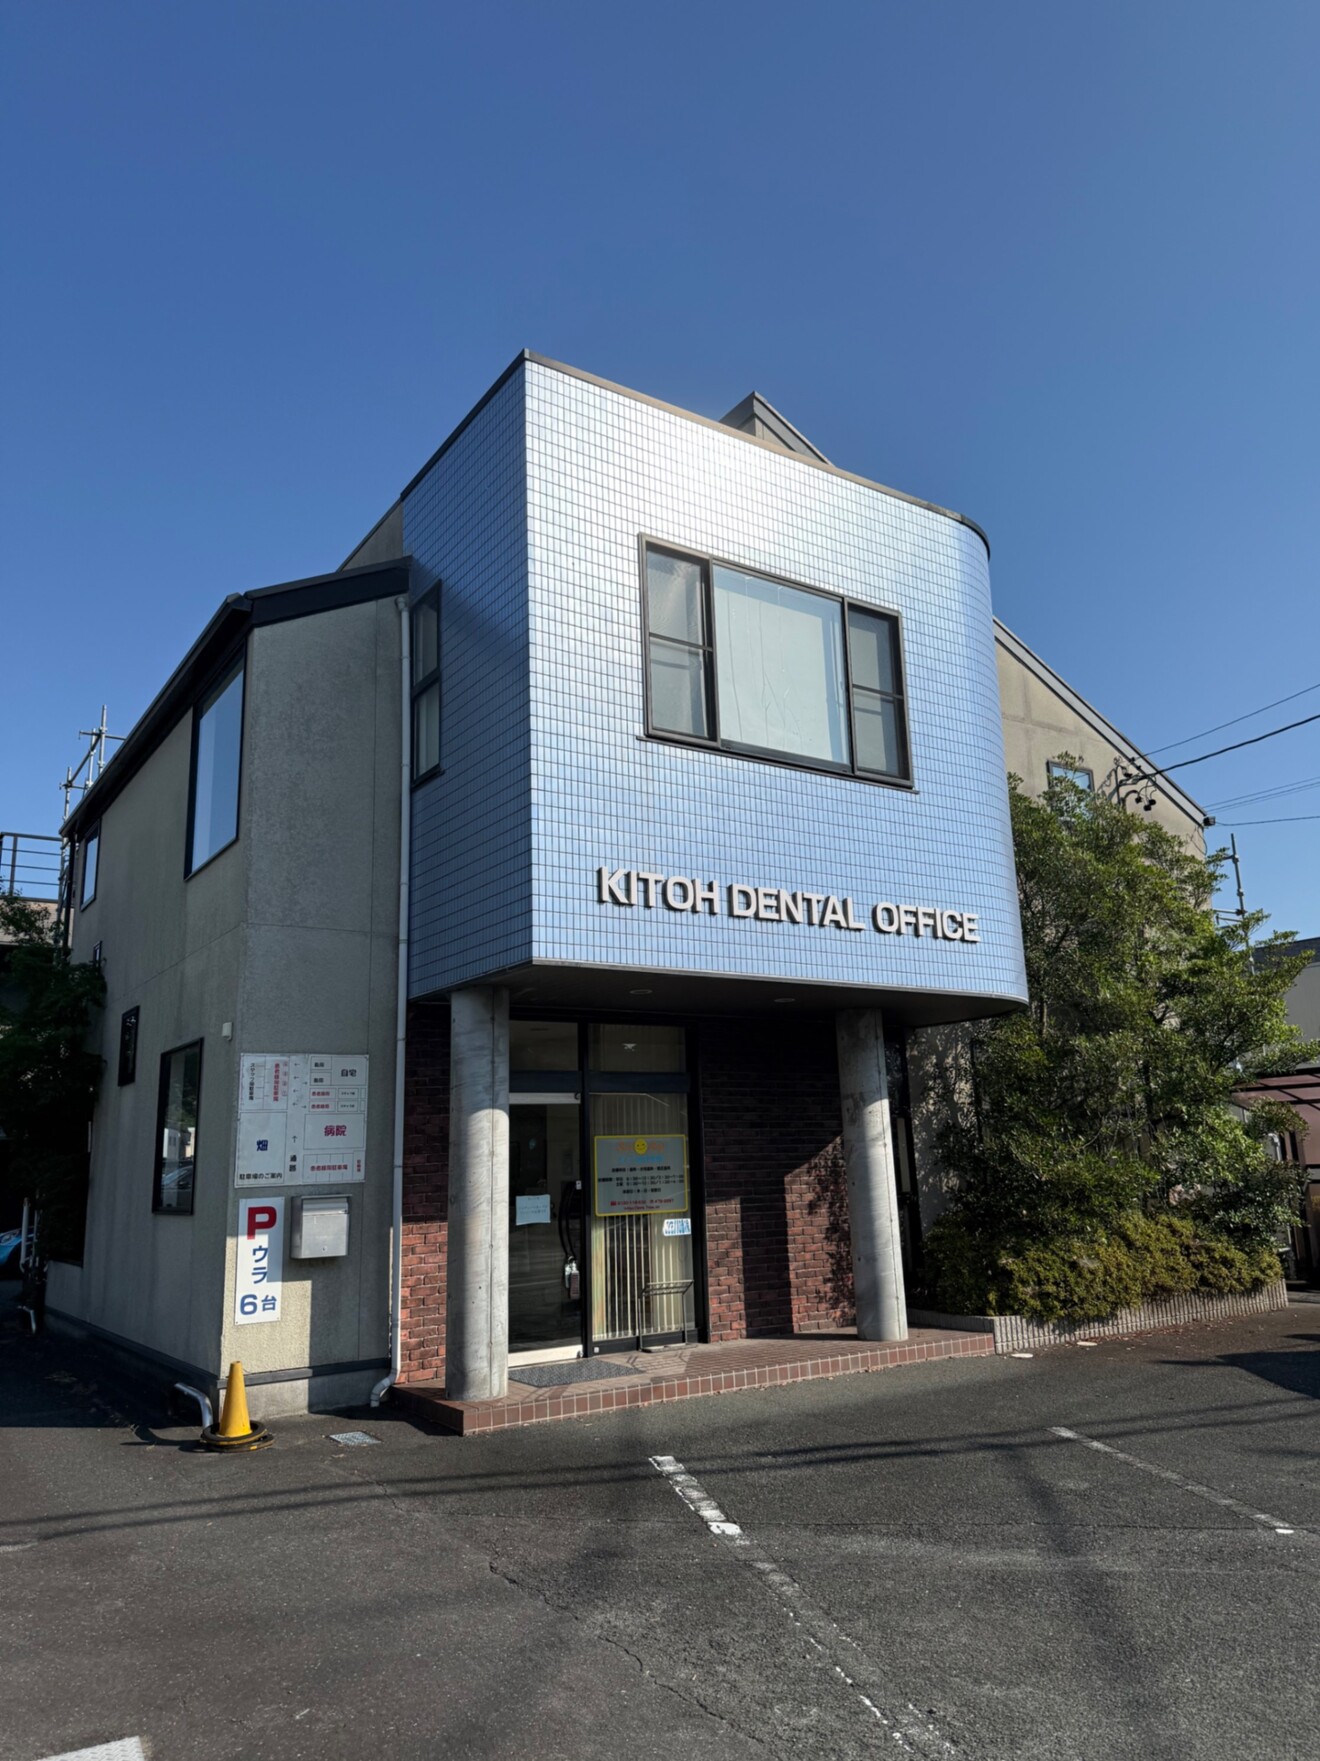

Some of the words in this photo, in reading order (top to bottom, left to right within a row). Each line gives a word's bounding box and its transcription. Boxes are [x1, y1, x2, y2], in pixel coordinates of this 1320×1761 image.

[598, 867, 718, 914] KITOH
[728, 883, 866, 931] DENTAL
[873, 901, 981, 944] OFFICE
[341, 1068, 357, 1077] 自宅
[324, 1124, 347, 1137] 病院
[256, 1139, 269, 1152] 畑
[239, 1172, 283, 1180] 駐車場のご案内
[247, 1206, 277, 1240] P
[251, 1245, 269, 1284] ウラ
[240, 1293, 277, 1315] 6台
